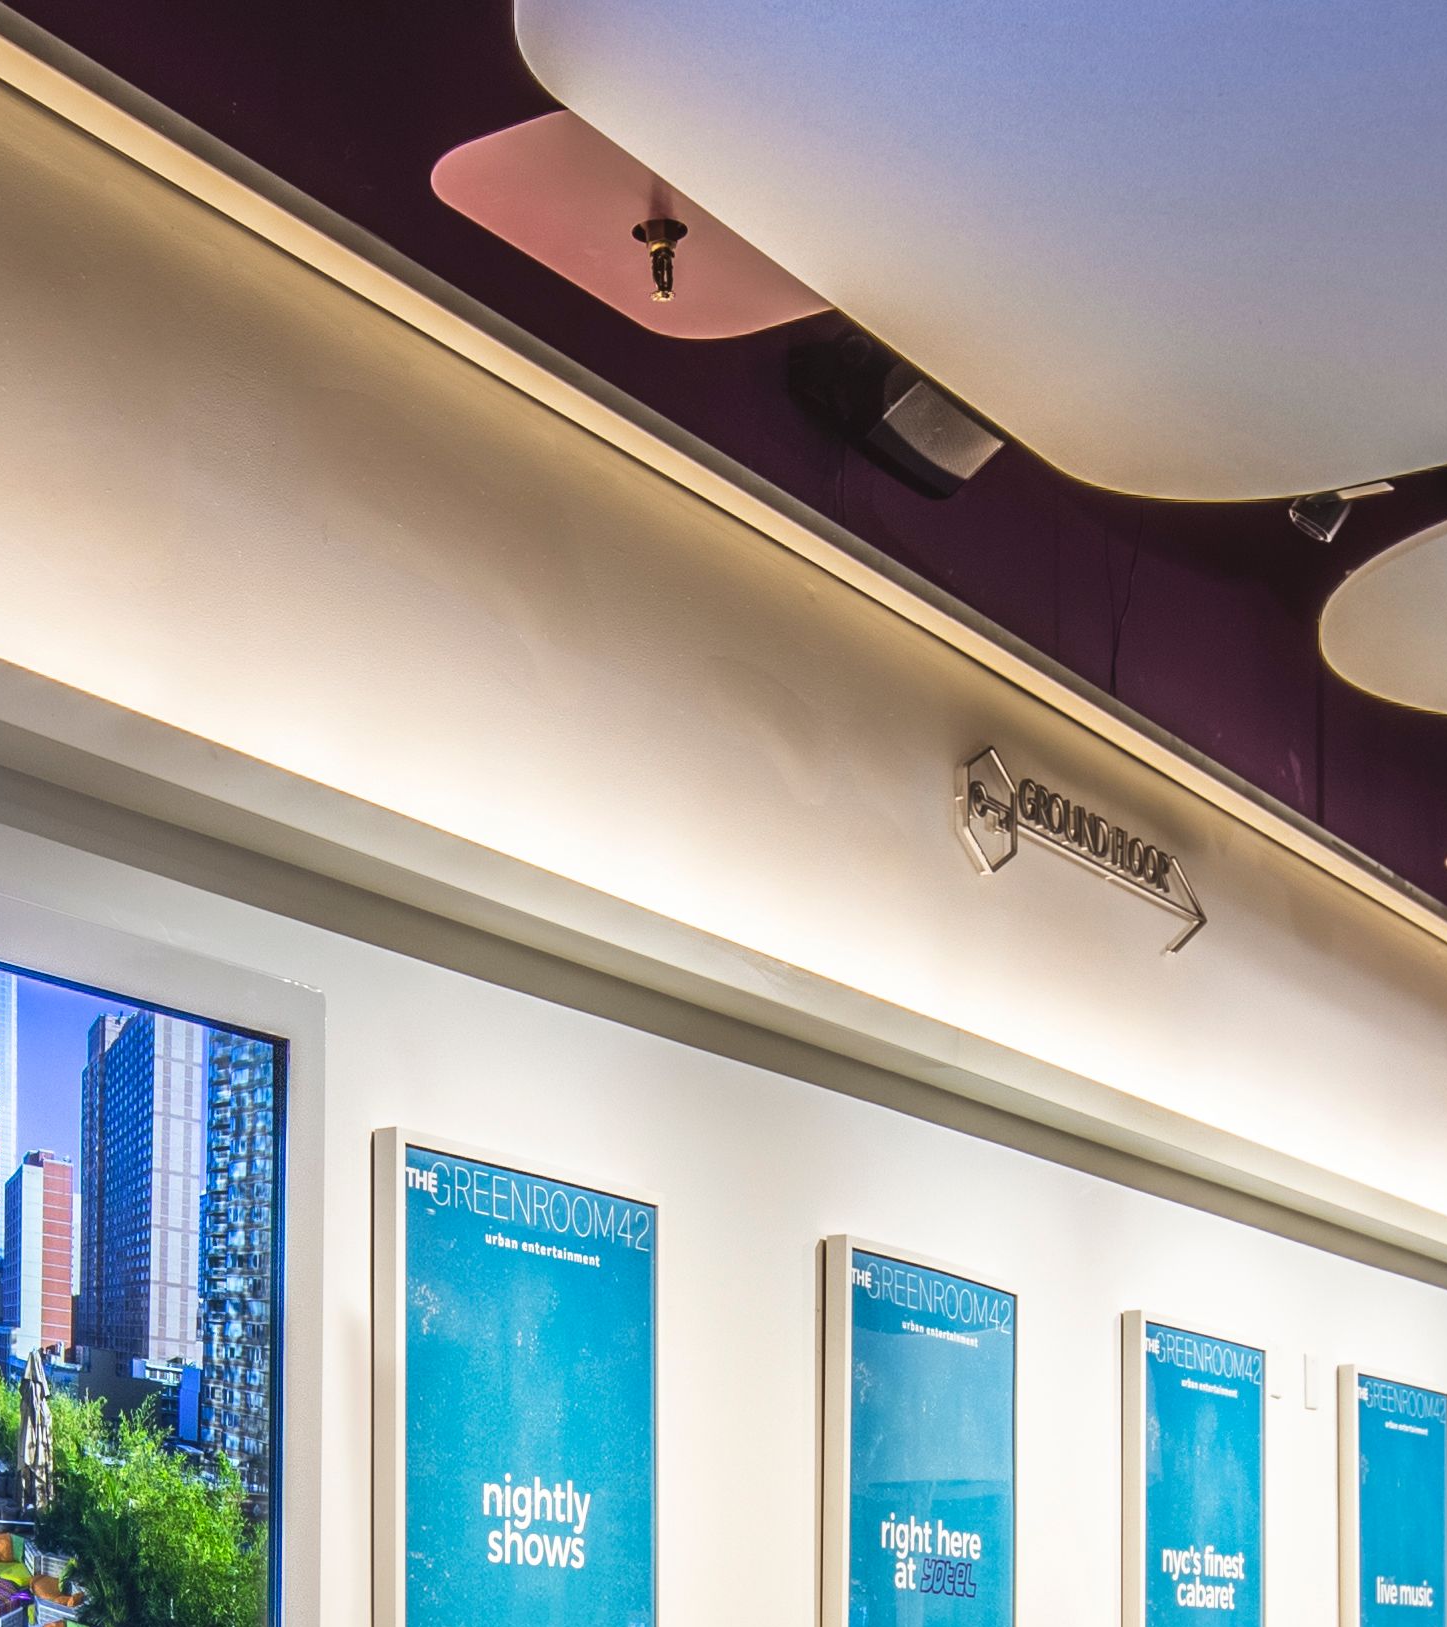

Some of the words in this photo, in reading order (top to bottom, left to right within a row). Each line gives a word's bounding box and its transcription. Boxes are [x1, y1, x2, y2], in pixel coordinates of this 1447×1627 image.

[1018, 778, 1108, 857] GROUND
[1111, 827, 1170, 892] FLOOR
[406, 1167, 437, 1193] THE
[485, 1233, 517, 1249] urban
[522, 1241, 601, 1267] entertainment
[852, 1267, 872, 1288] THE
[902, 1320, 924, 1333] urban
[926, 1327, 978, 1347] entertainment
[482, 1473, 591, 1532] nightly
[487, 1520, 585, 1569] shows
[881, 1513, 932, 1558] right
[937, 1520, 981, 1560] here
[895, 1558, 916, 1590] at
[1163, 1546, 1201, 1581] nyc's
[1204, 1546, 1245, 1579] finest
[1176, 1577, 1235, 1609] cabaret
[1377, 1576, 1398, 1604] live
[1400, 1581, 1433, 1607] music
